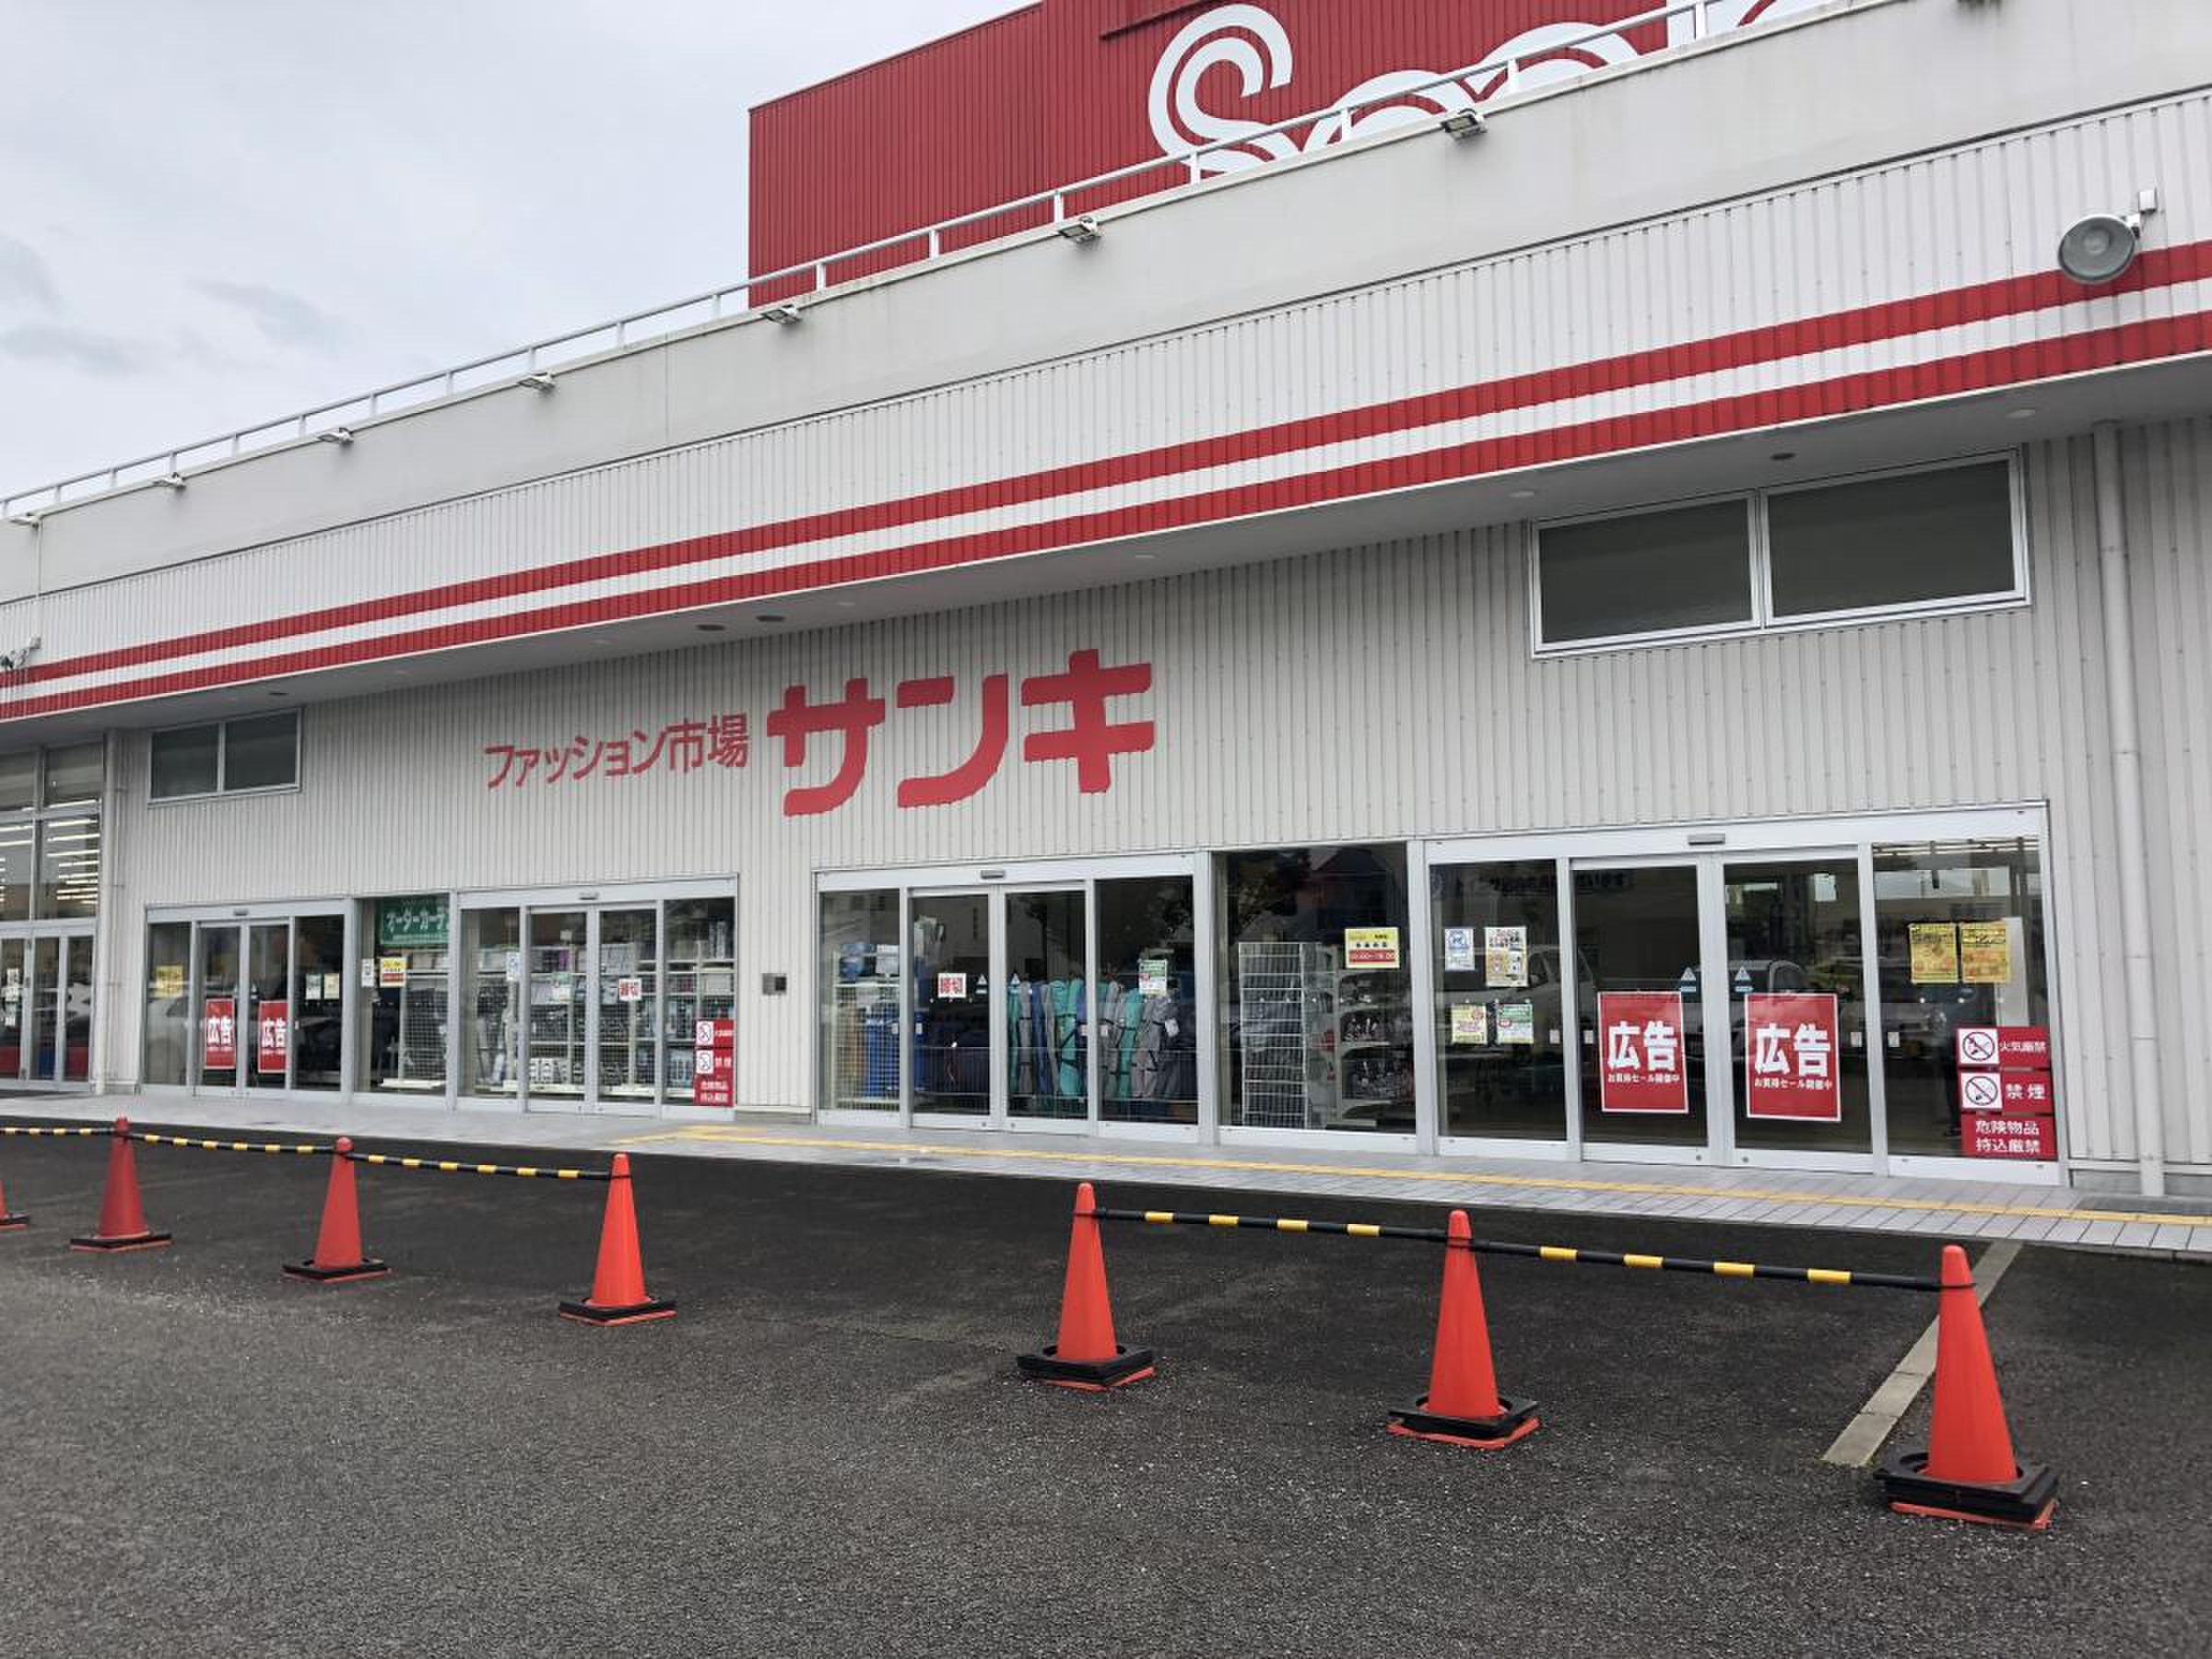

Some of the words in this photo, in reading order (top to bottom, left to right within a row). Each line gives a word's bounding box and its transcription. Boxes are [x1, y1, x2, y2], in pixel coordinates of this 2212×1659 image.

[485, 713, 749, 789] ファッション市場
[767, 649, 1156, 818] サンキ
[207, 1016, 231, 1044] 広告
[262, 1018, 287, 1047] 広告
[1607, 1020, 1678, 1071] 広告
[1754, 1023, 1830, 1077] 広告
[2006, 1084, 2045, 1100] 禁煙
[1975, 1120, 2040, 1135] 危険物品
[1975, 1137, 2041, 1153] 持込厳禁
